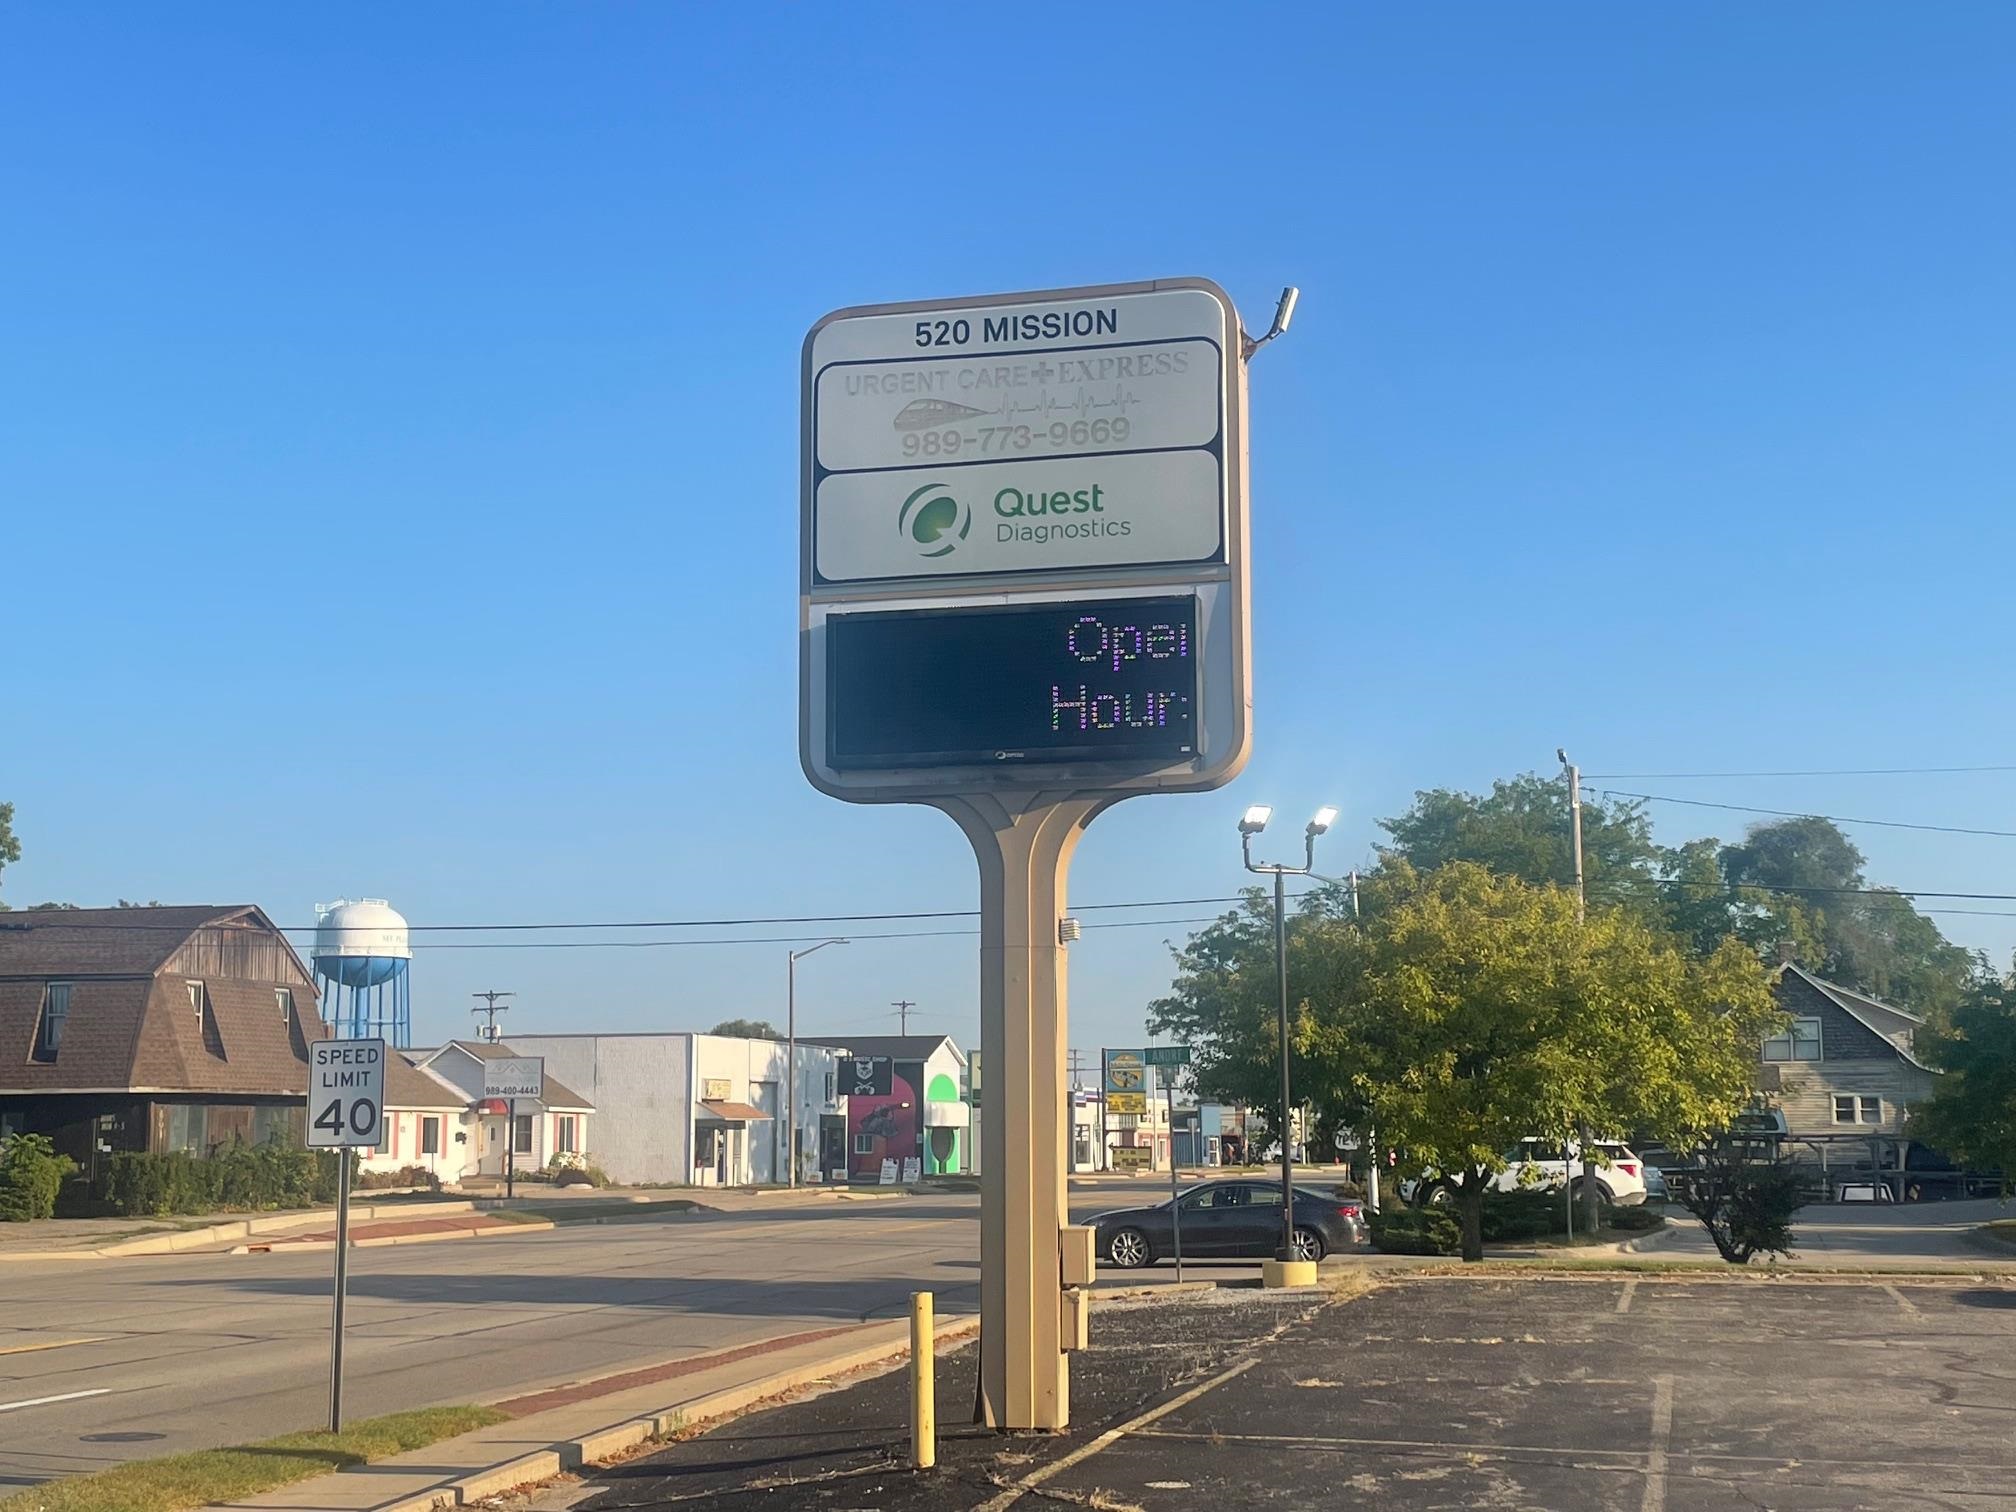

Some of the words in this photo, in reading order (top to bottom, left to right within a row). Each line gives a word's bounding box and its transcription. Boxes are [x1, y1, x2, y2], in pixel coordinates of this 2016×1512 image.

[915, 319, 970, 347] 520
[984, 309, 1118, 343] MISSION
[845, 370, 950, 397] URGENT
[1058, 351, 1190, 385] EXPRESS
[902, 417, 1132, 457] 989-773-9669
[994, 483, 1104, 518] Quest
[997, 517, 1132, 545] Diagnostics
[1052, 684, 1188, 730] Hour
[317, 1048, 378, 1065] SPEED
[323, 1071, 371, 1088] LIMIT
[314, 1097, 377, 1136] 40
